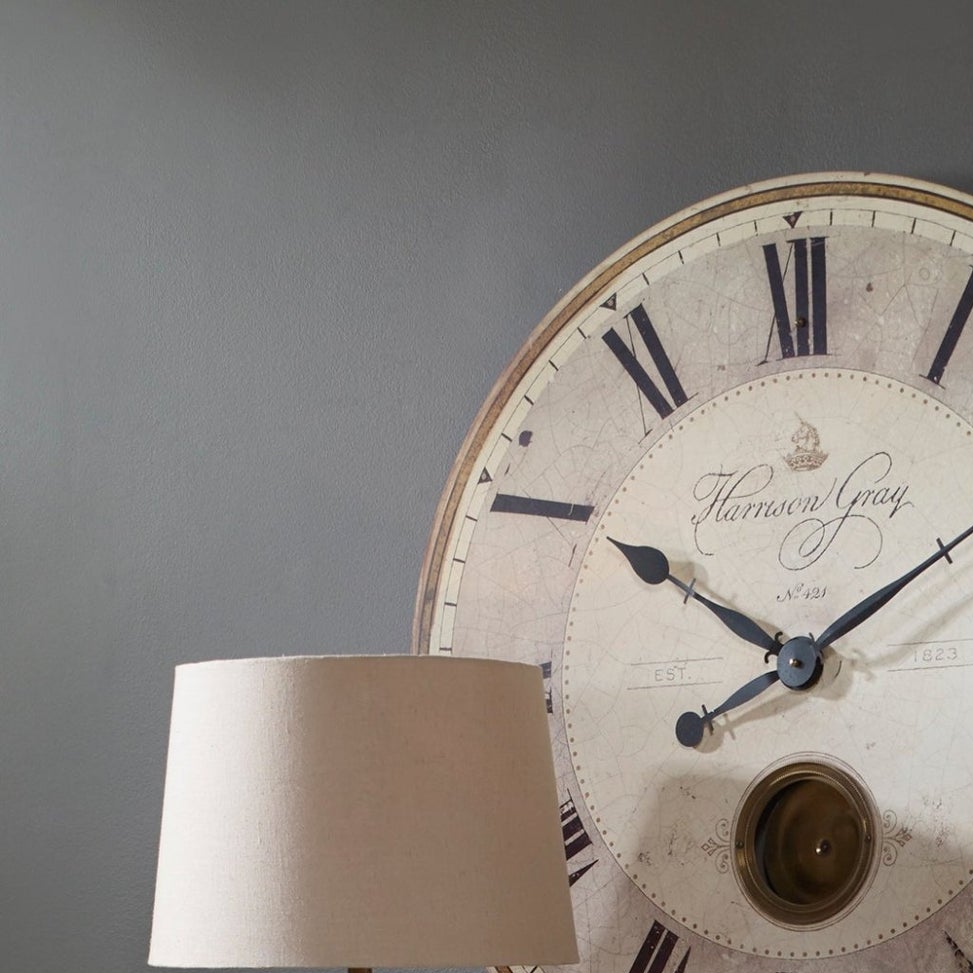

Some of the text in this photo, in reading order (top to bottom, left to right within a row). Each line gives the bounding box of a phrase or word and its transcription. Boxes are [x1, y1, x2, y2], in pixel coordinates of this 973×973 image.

[759, 236, 831, 366] XII
[601, 303, 698, 434] XI
[691, 464, 838, 556] Harrison
[654, 666, 692, 683] EST.
[912, 646, 959, 663] 1823
